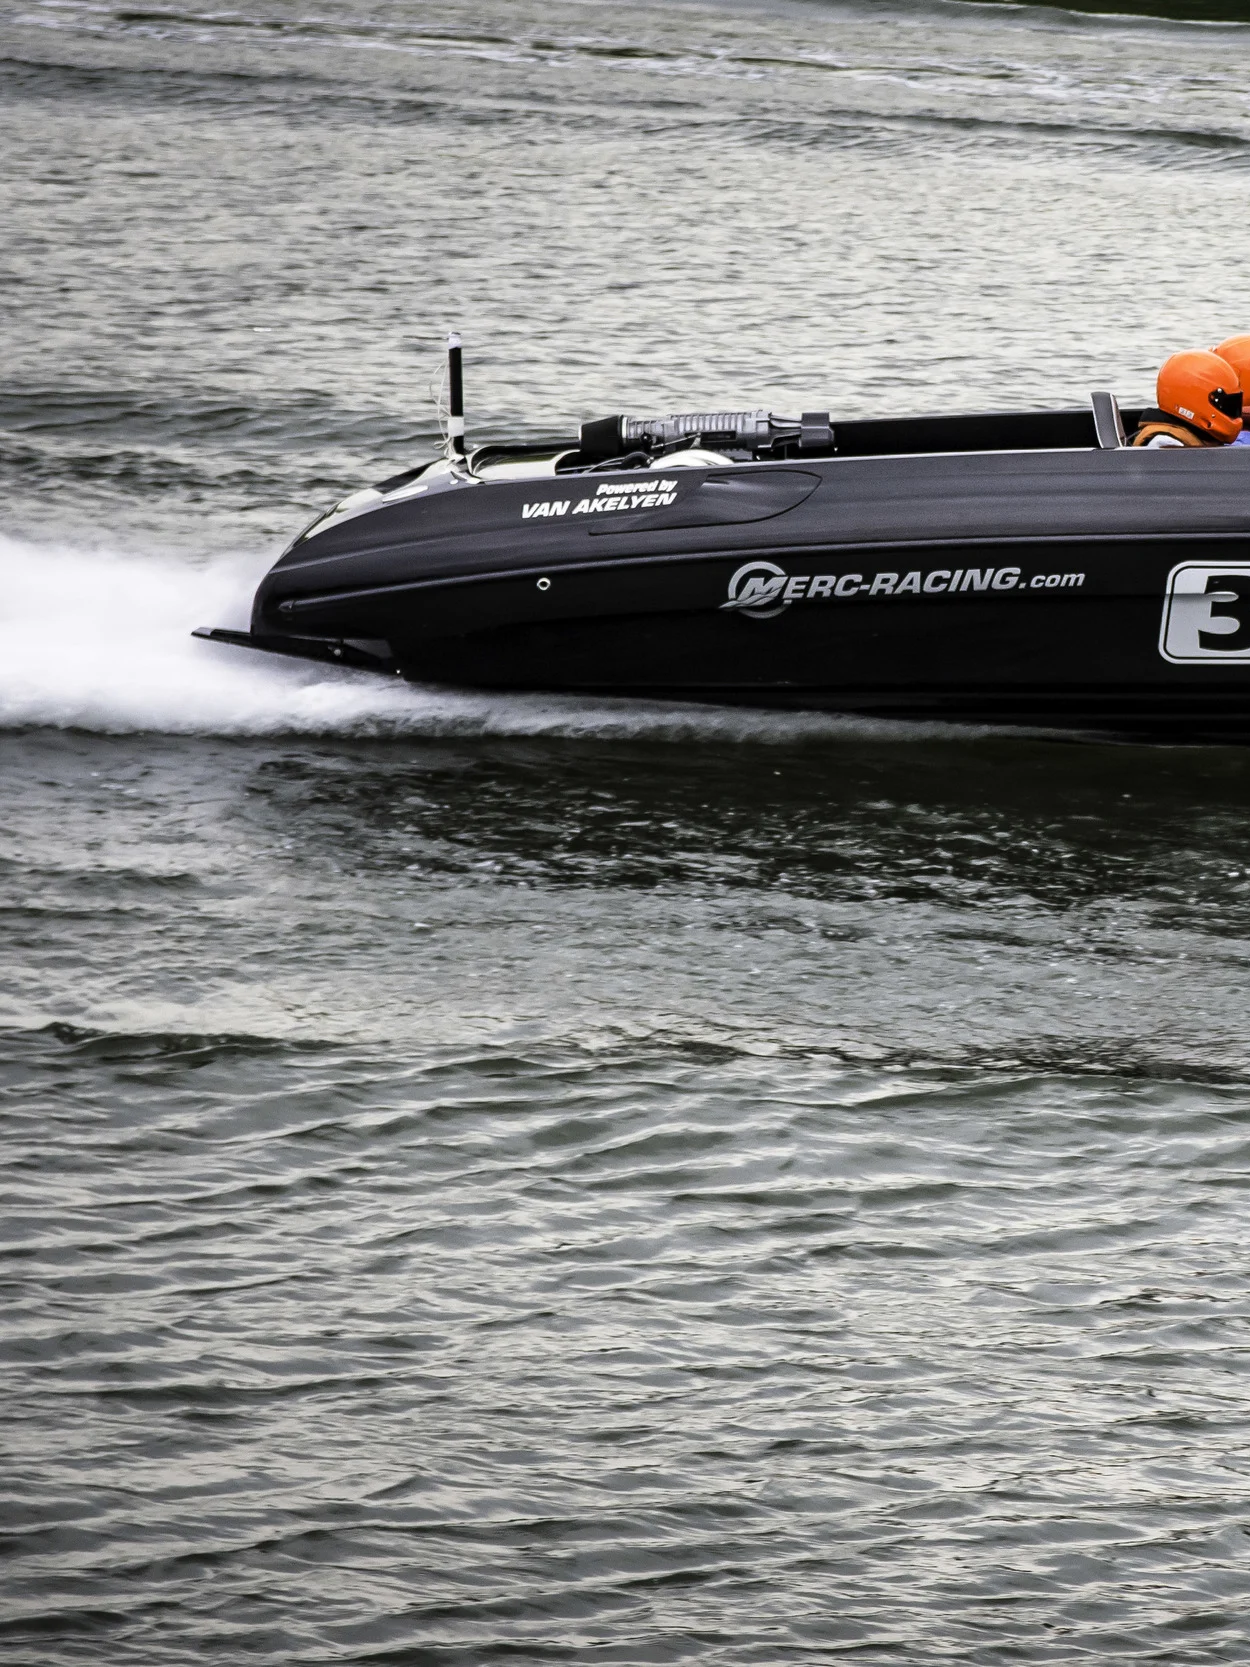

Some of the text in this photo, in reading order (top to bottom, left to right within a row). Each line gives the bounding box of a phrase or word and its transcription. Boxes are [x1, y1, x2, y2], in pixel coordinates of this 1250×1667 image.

[596, 479, 678, 495] Powered by
[522, 493, 677, 518] VAN AKELYEN
